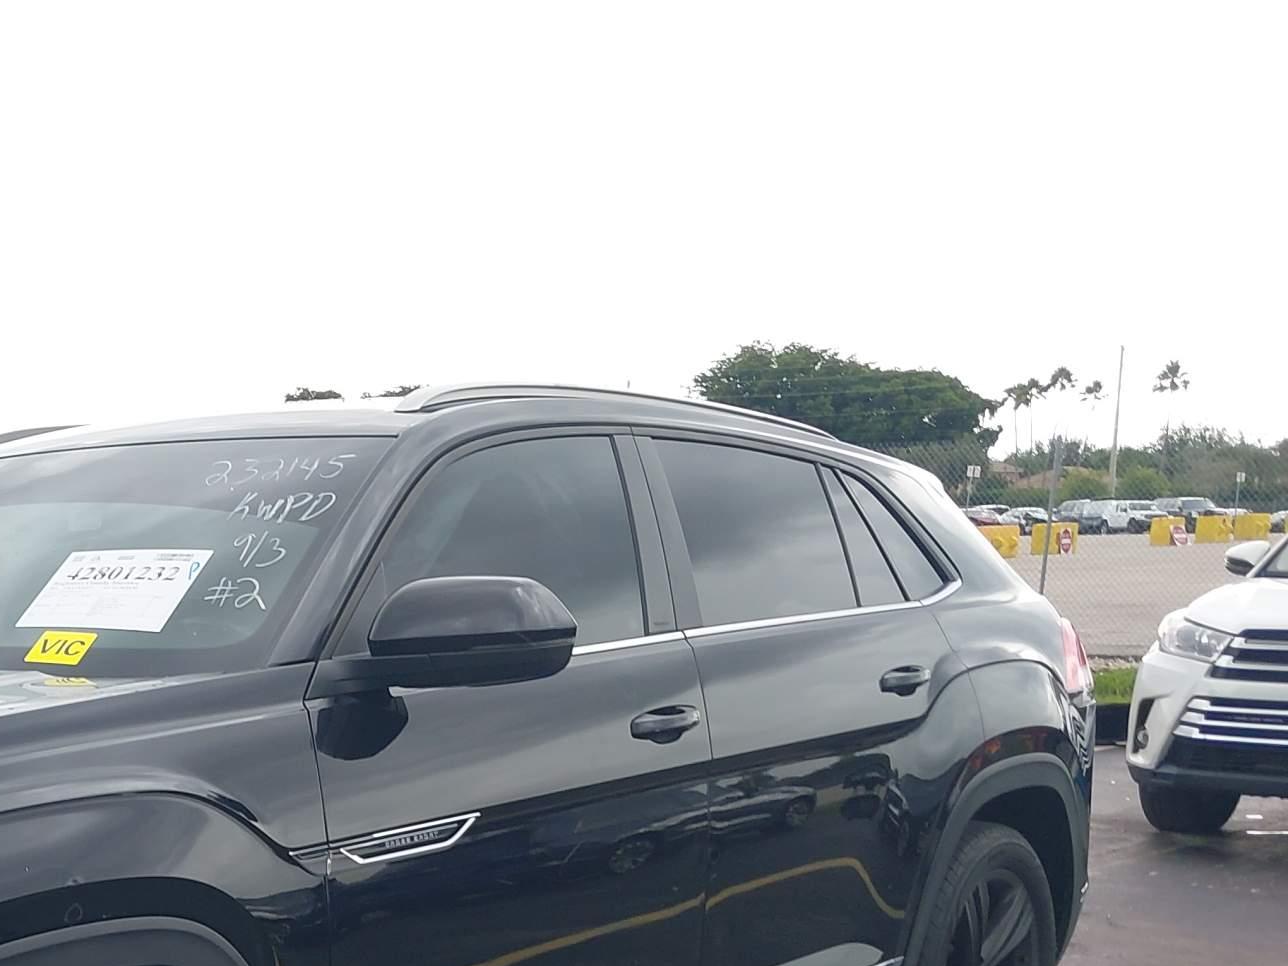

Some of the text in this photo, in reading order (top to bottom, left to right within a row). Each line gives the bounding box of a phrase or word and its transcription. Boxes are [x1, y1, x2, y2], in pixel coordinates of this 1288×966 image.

[205, 454, 357, 487] 232145
[233, 530, 287, 568] 9/3
[67, 566, 181, 581] 42801232
[203, 576, 267, 611] #2
[40, 638, 87, 656] VIC
